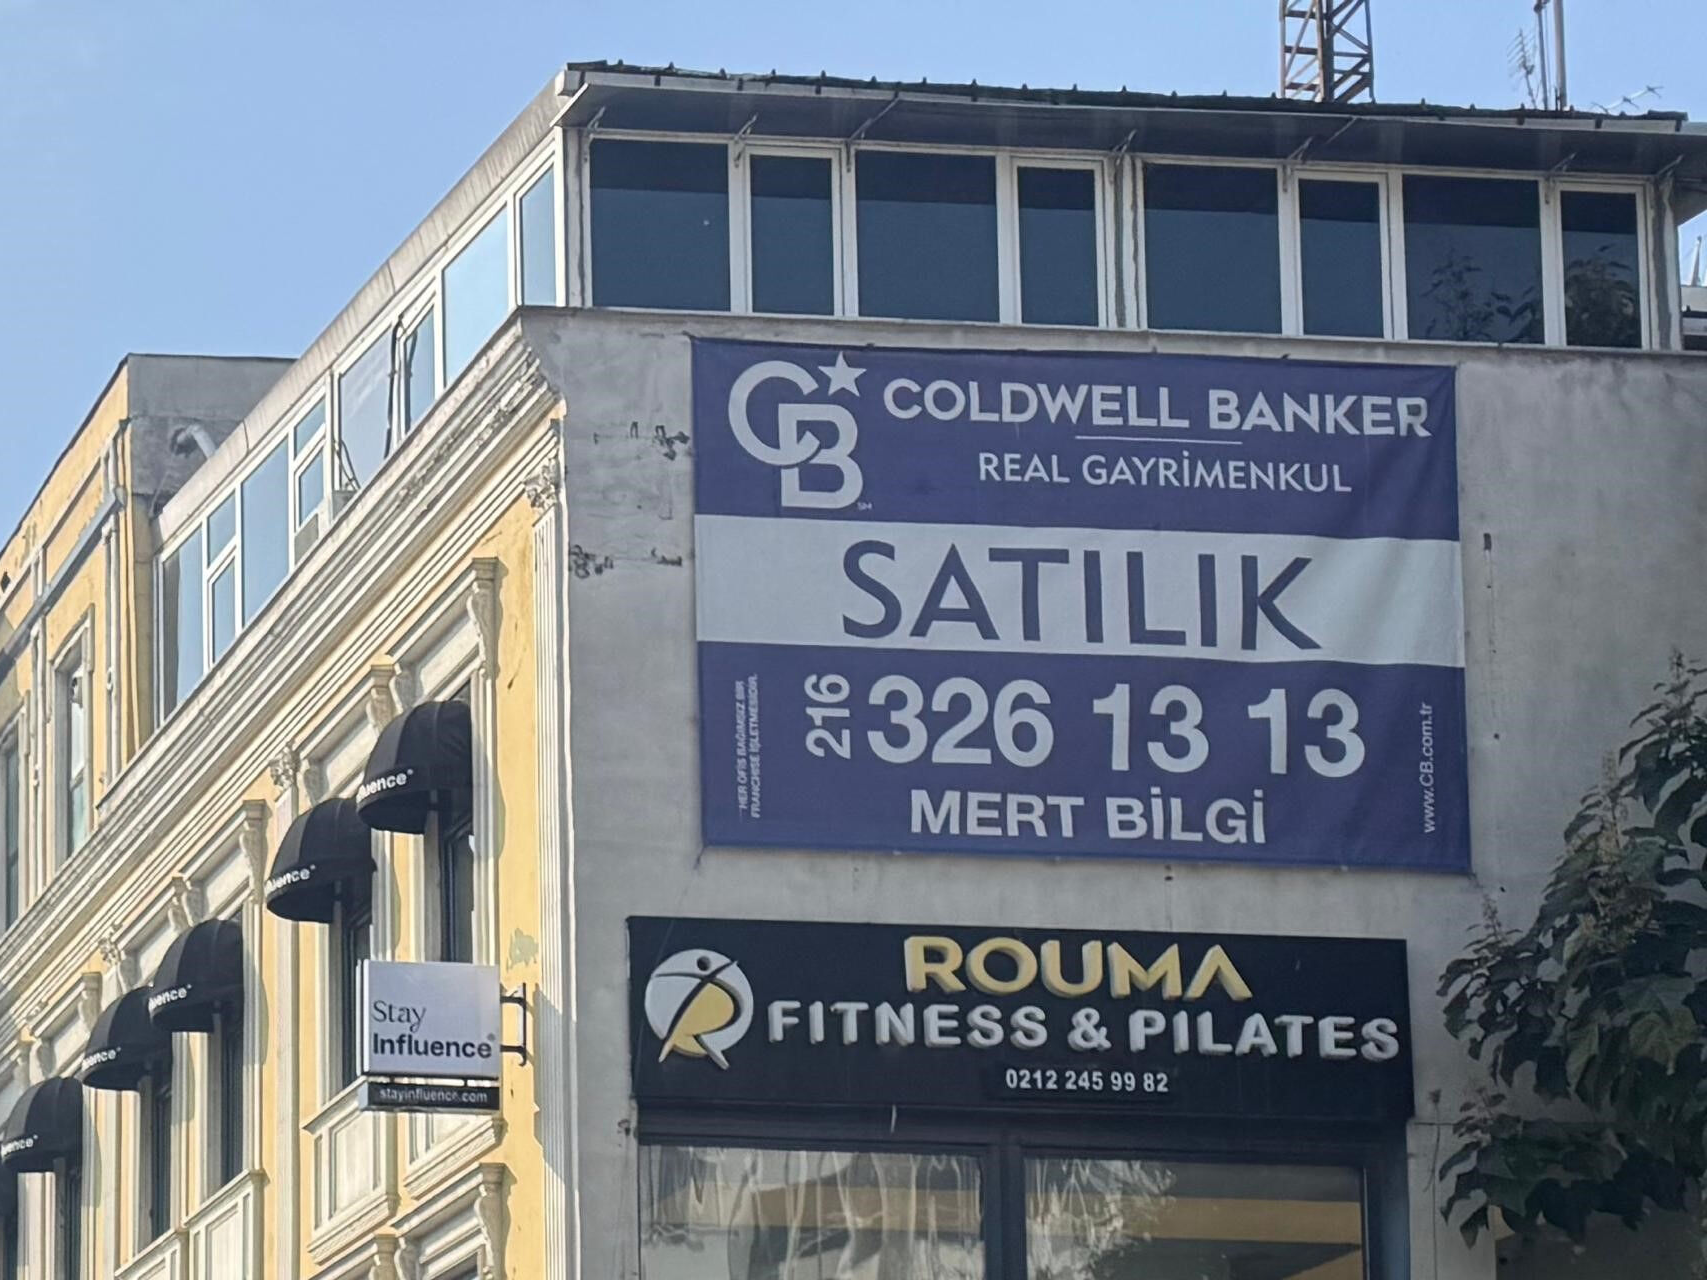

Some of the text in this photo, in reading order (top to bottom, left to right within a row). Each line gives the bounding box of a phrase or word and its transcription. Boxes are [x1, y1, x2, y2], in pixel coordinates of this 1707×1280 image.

[884, 378, 1430, 437] COLDWELL BANKER
[979, 450, 1352, 493] REAL GAYRİMENKUL
[842, 540, 1322, 651] SATILIK
[804, 674, 1366, 777] 216 326 13 13
[1419, 702, 1436, 833] www.CB.com.tr
[911, 787, 1266, 844] MERT BİLGİ
[903, 936, 1253, 999] ROUMA
[372, 1000, 427, 1033] Stay
[768, 1001, 1400, 1062] FITNESS & PILATES
[373, 1033, 492, 1059] Influence
[379, 1087, 488, 1103] stayinfluence.com
[1005, 1068, 1169, 1092] 0212 245 99 82
